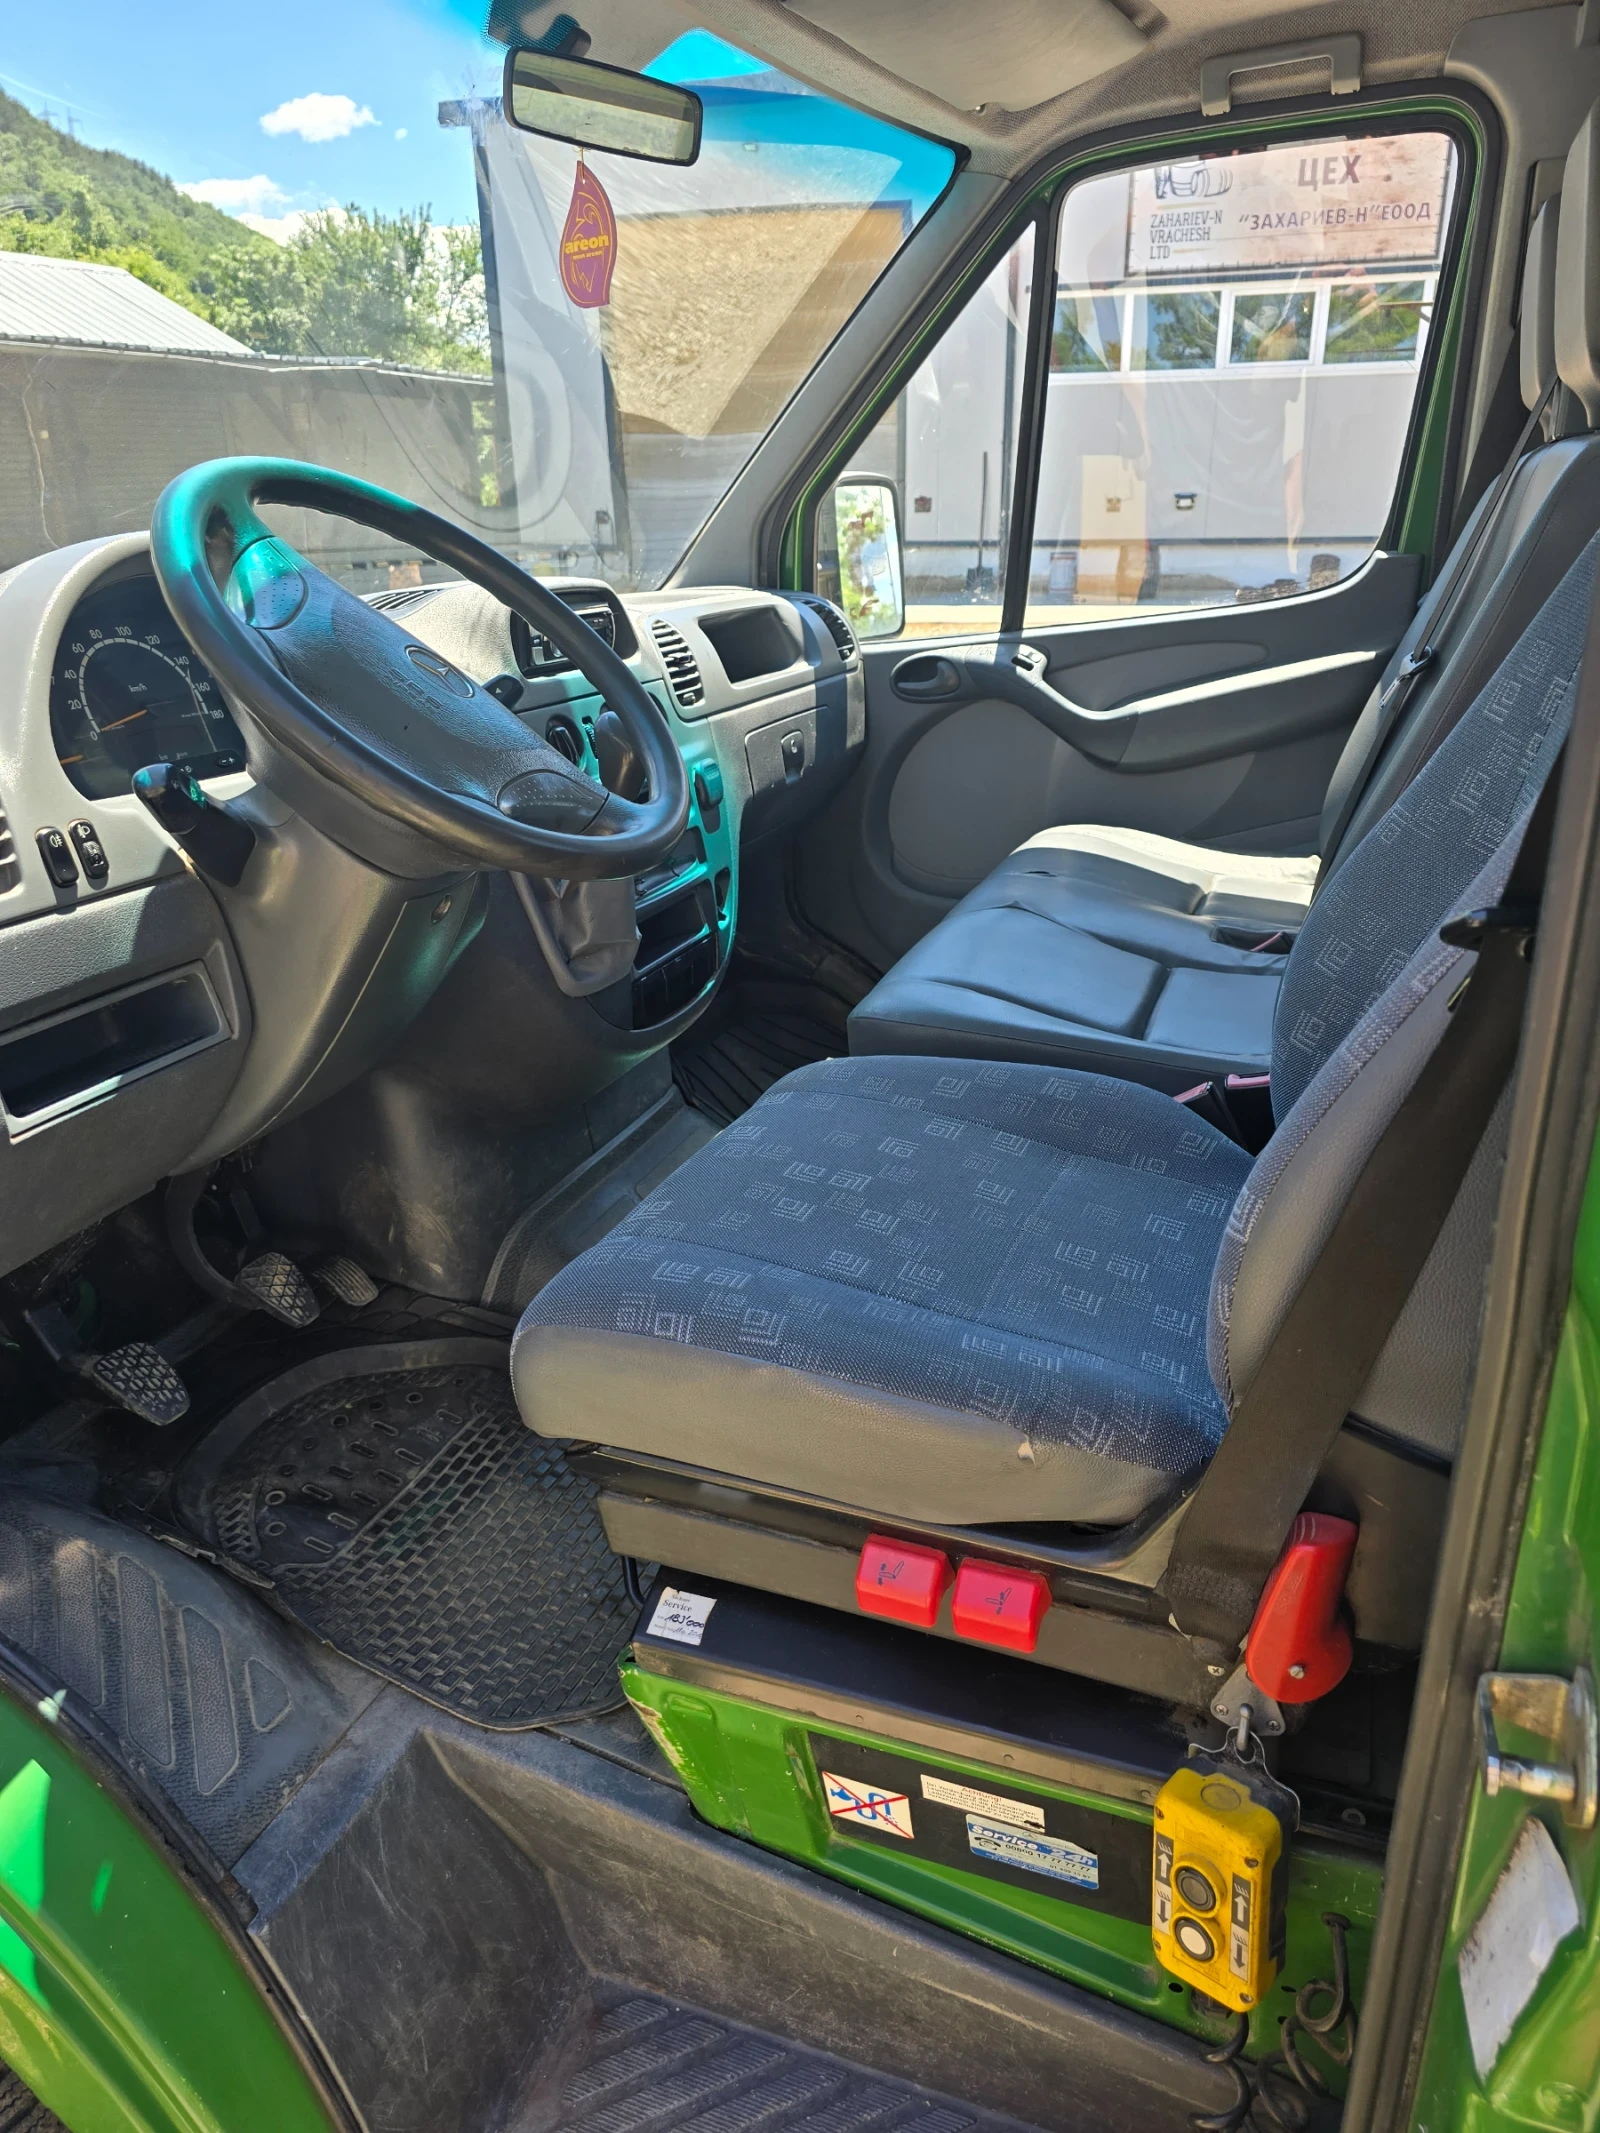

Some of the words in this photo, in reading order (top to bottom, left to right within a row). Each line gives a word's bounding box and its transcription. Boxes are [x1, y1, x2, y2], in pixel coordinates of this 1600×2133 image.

[1298, 155, 1362, 192] ЦЕХ
[1150, 210, 1223, 228] ZAHARIEV-N
[1149, 226, 1211, 244] VRACHESH
[565, 234, 609, 254] areon
[1149, 245, 1171, 260] LTD
[89, 629, 102, 640] 80
[115, 626, 132, 636] 100
[145, 634, 160, 645] 120
[72, 643, 85, 654] 60
[174, 656, 189, 666] 140
[64, 669, 77, 680] 40
[128, 683, 148, 693] km/h
[195, 682, 210, 692] 160
[68, 700, 82, 710] 20
[209, 710, 224, 720] 180
[90, 731, 98, 741] 0
[662, 1600, 693, 1612] Service
[971, 1824, 1039, 1851] Service
[1049, 1848, 1094, 1866] 24h
[1005, 1844, 1034, 1857] 00800
[1050, 1856, 1062, 1864] 77
[1079, 1864, 1091, 1872] 77
